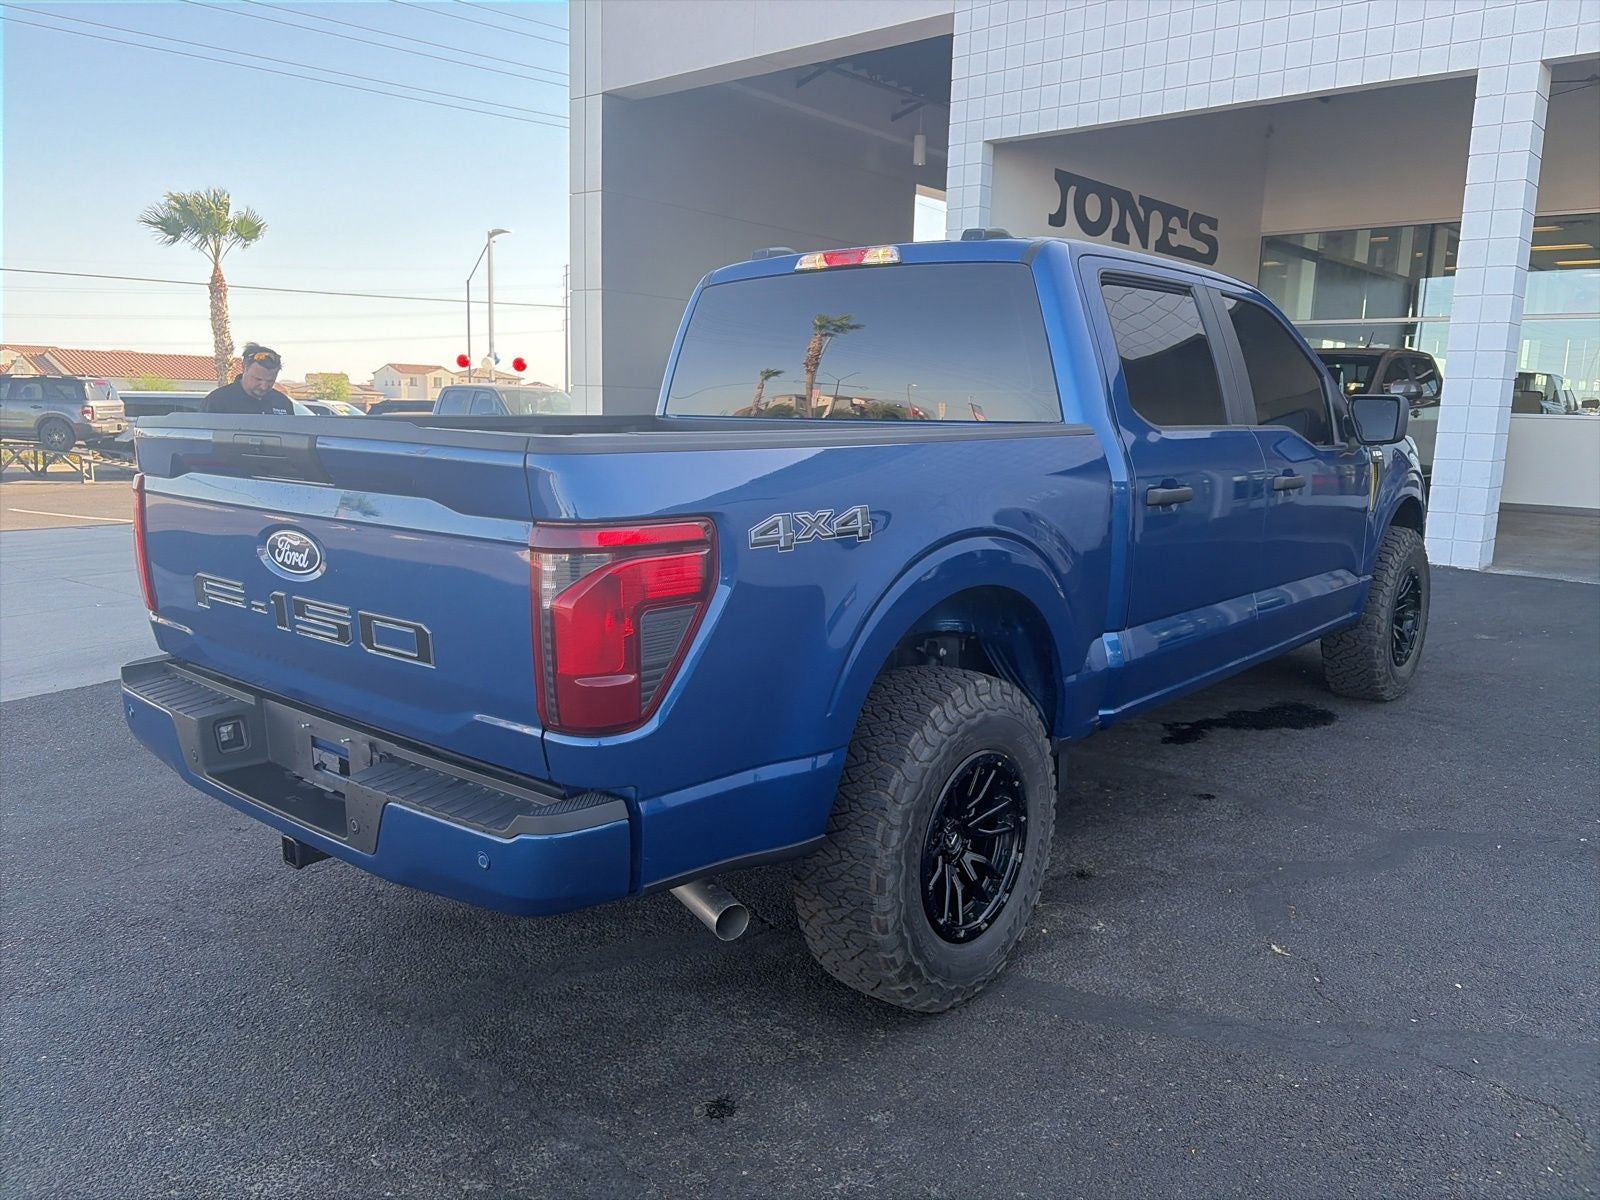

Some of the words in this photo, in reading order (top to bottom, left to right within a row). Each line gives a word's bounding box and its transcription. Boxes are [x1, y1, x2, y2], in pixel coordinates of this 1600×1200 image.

[1048, 168, 1219, 266] JONES
[274, 535, 310, 569] Ford
[193, 571, 436, 669] F-150
